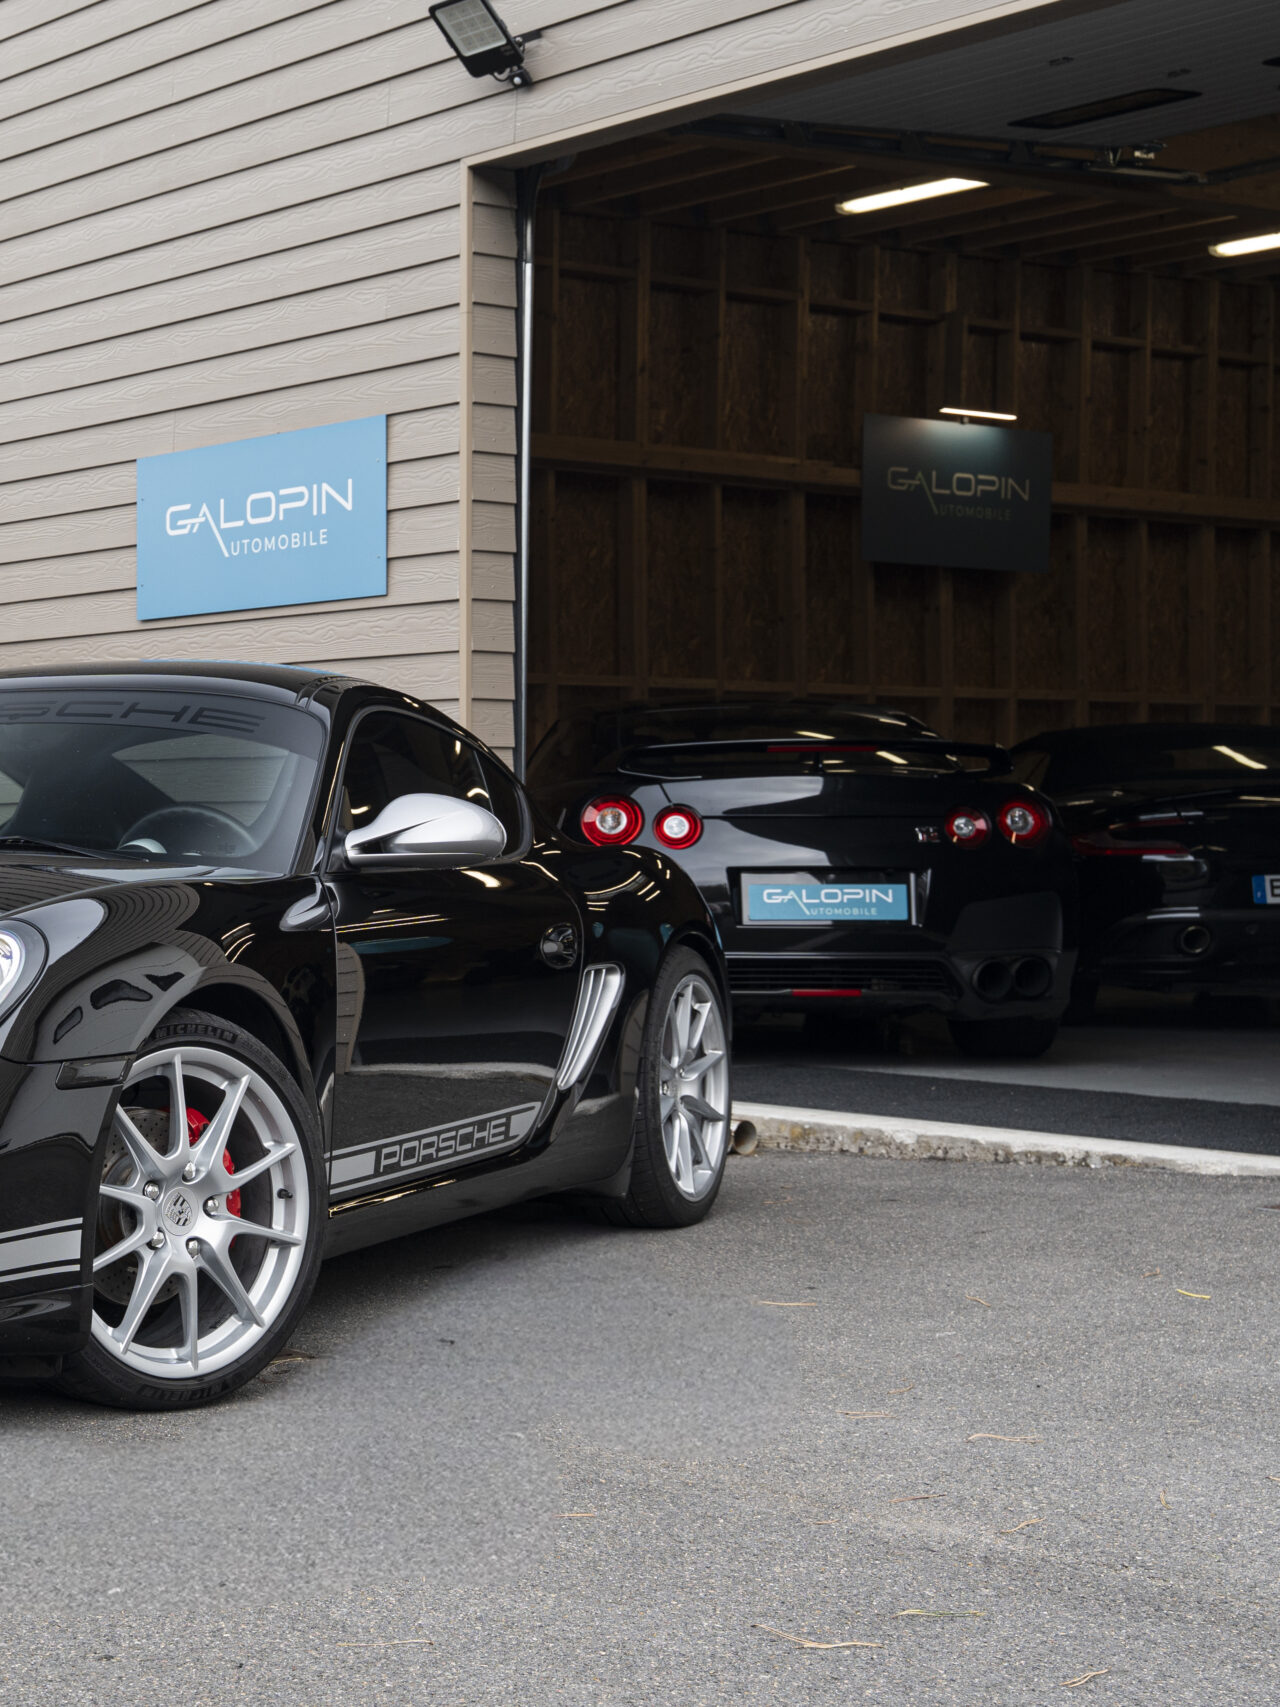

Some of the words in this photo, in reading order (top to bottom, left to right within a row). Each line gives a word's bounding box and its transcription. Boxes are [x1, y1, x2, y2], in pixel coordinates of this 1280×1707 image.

[887, 466, 1030, 515] GALOPIN
[165, 478, 353, 558] GALOPIN
[762, 888, 894, 915] GALOPIN
[155, 1024, 235, 1041] MICHELIN
[379, 1117, 508, 1173] PORSCHE
